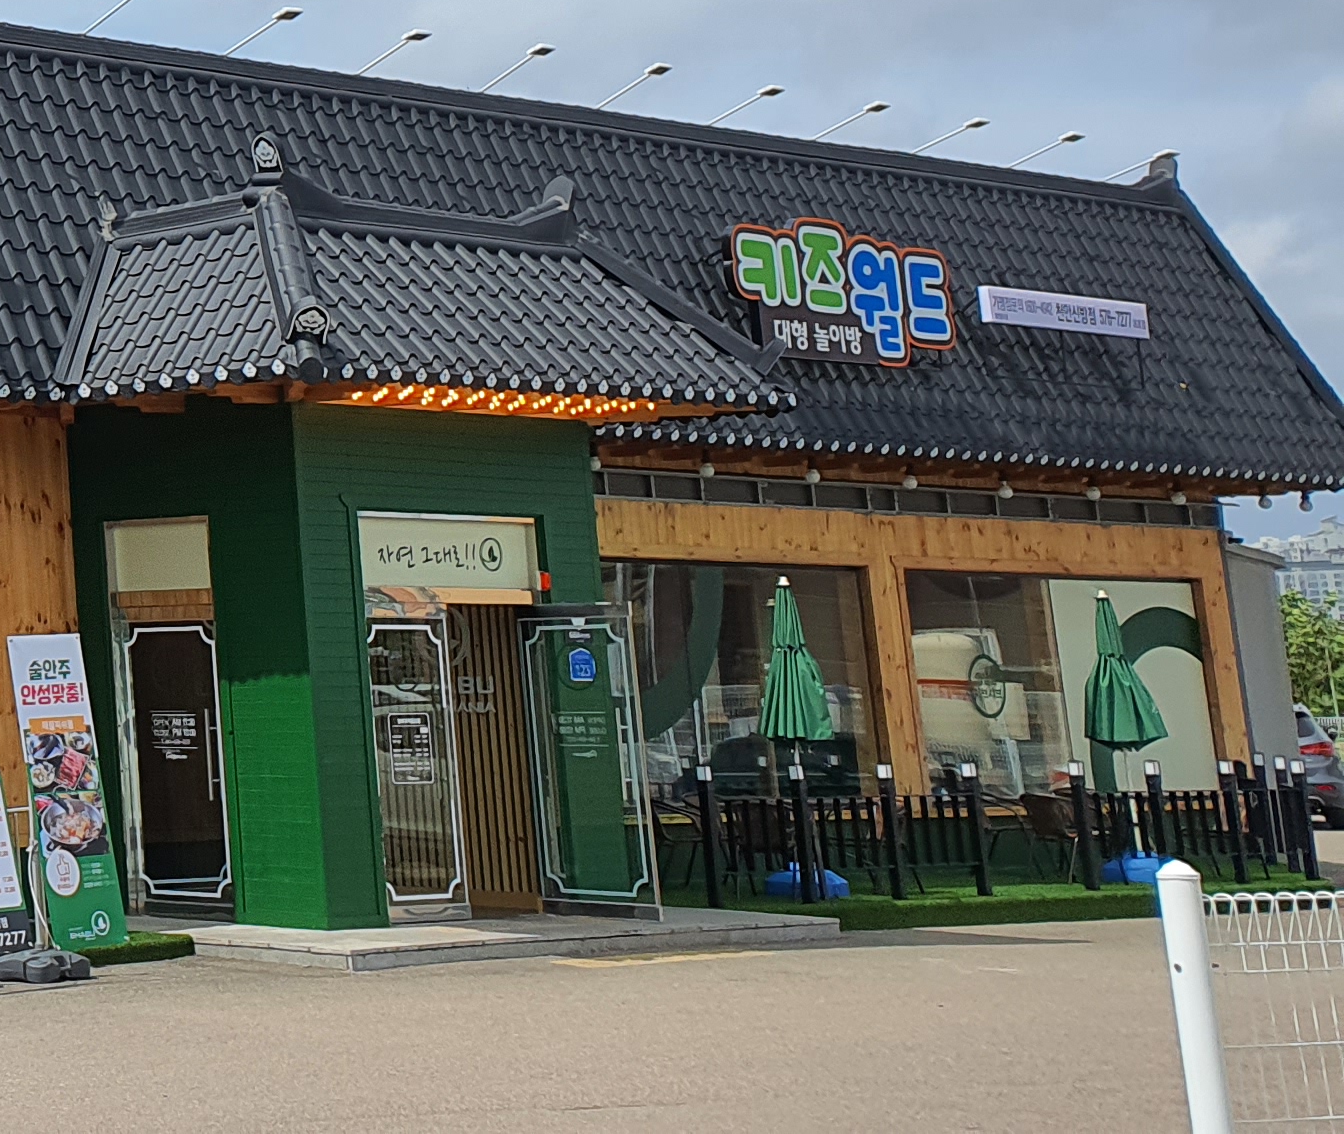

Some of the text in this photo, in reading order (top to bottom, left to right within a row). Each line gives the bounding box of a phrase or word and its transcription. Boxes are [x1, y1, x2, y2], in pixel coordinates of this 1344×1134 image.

[736, 227, 952, 357] 키즈월드
[773, 319, 863, 355] 대형 놀이방
[378, 544, 415, 569] 자연
[28, 659, 71, 681] 술안주
[20, 682, 84, 706] 안성맞춤!
